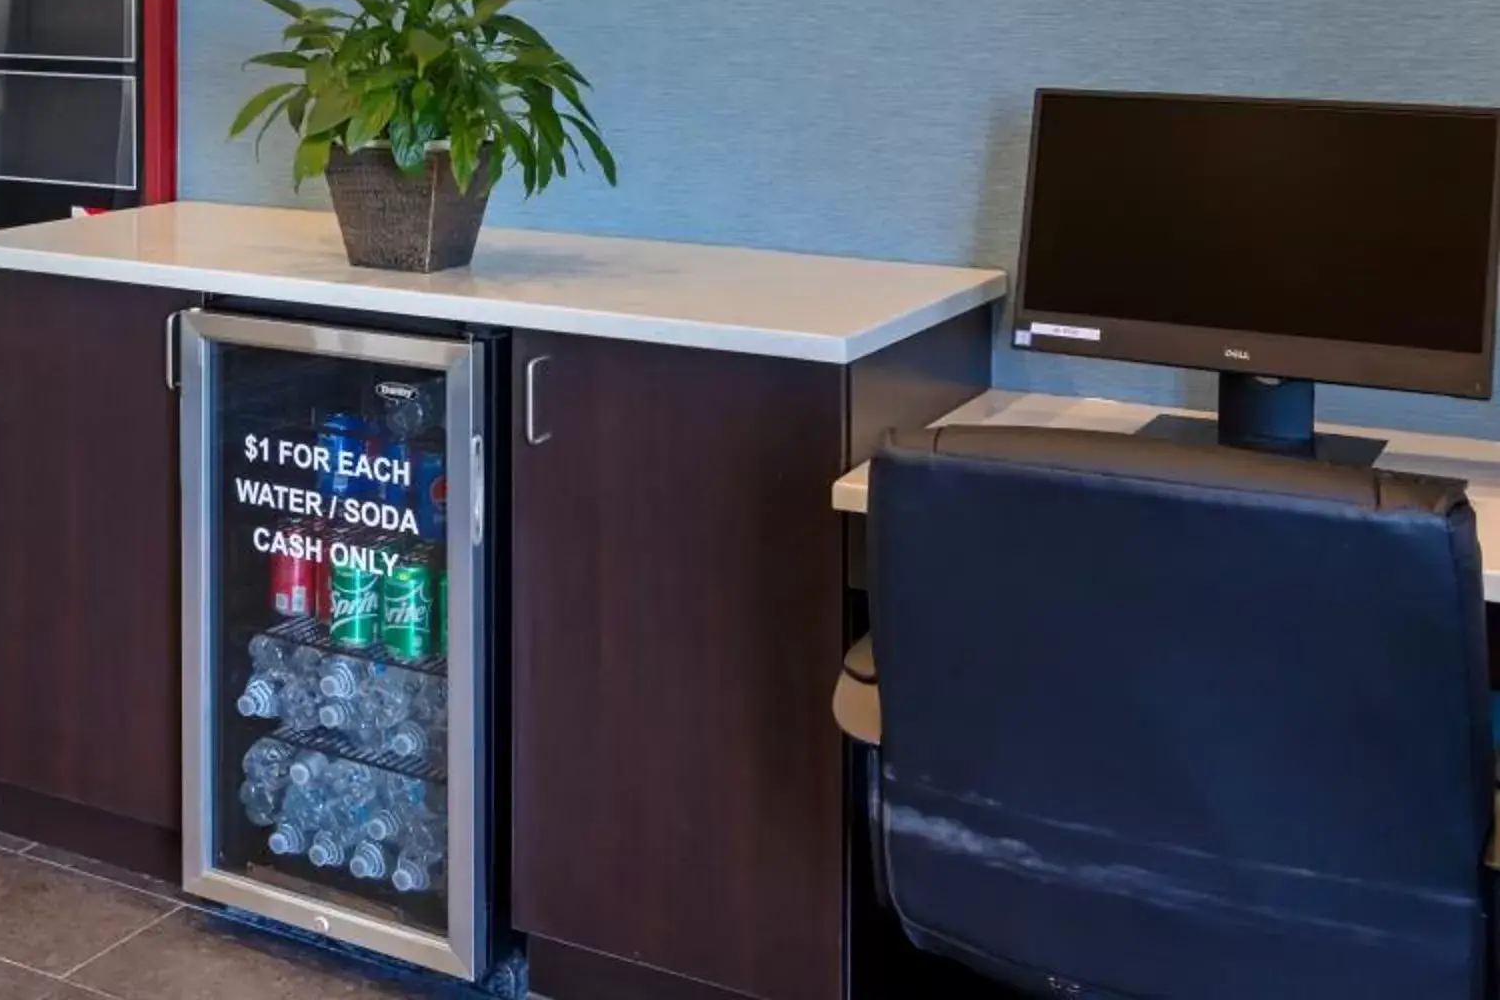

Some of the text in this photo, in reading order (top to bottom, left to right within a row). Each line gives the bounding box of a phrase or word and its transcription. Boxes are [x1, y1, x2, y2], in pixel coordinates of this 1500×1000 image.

[244, 433, 411, 487] $1 FOR EACH
[235, 477, 420, 535] WATER / SODA
[252, 526, 399, 577] CASH ONLY
